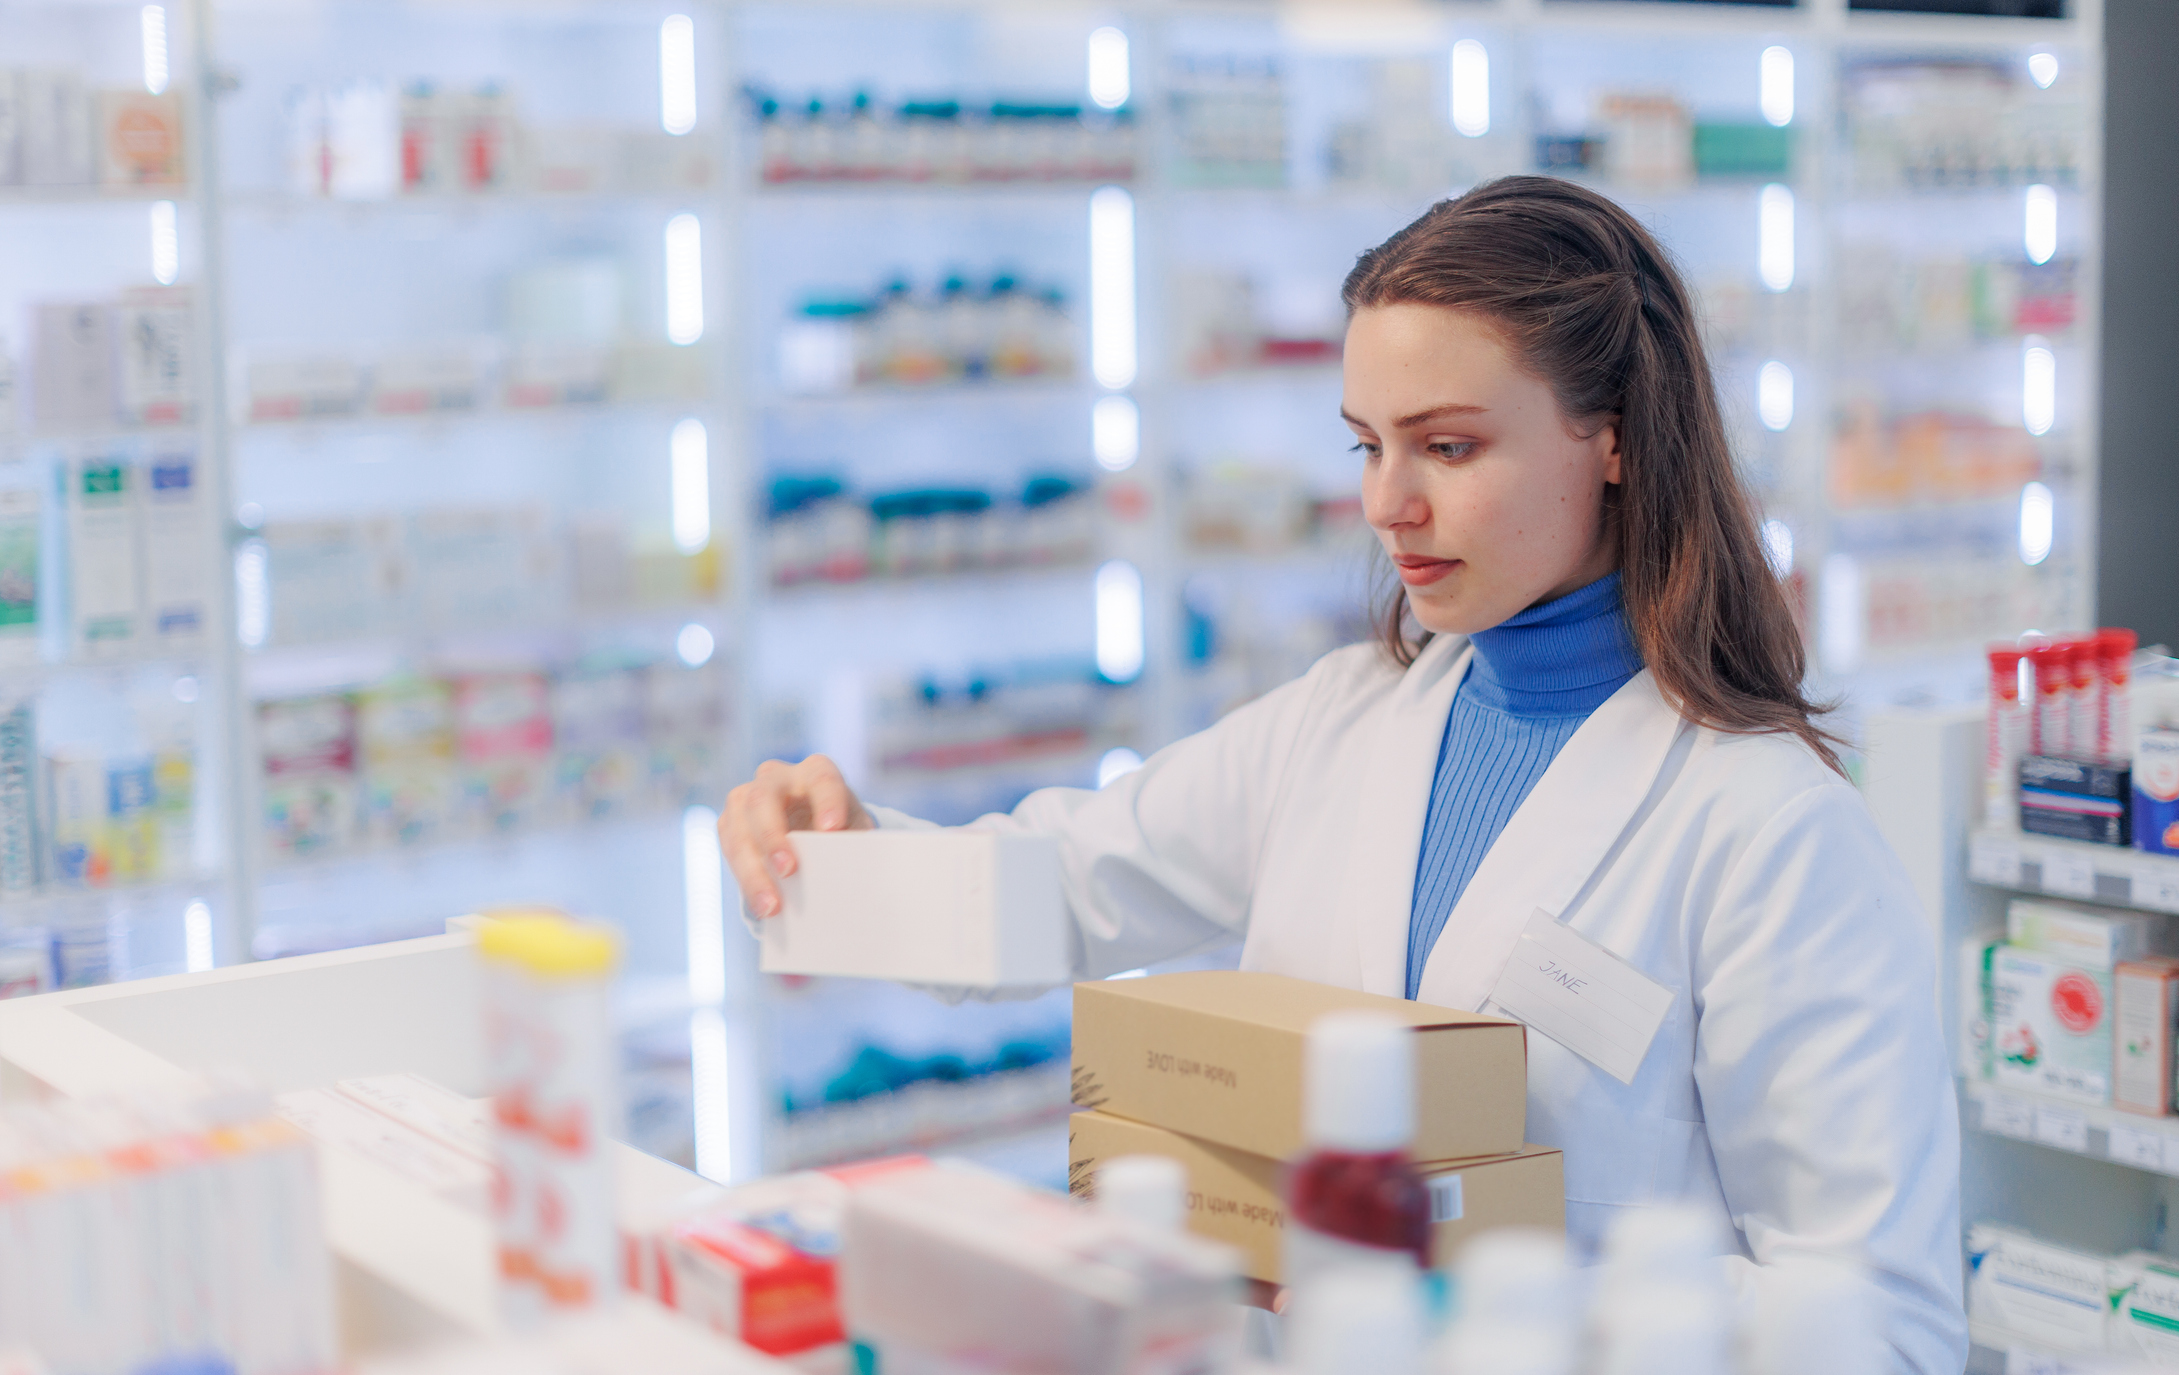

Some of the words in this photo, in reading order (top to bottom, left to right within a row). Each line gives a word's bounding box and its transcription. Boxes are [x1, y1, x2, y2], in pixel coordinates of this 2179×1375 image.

[1538, 959, 1588, 995] JANE
[1147, 1050, 1175, 1074] LOVE
[1177, 1058, 1202, 1078] with
[1203, 1063, 1237, 1088] Made
[1207, 1195, 1239, 1216] with
[1242, 1203, 1284, 1228] Made
